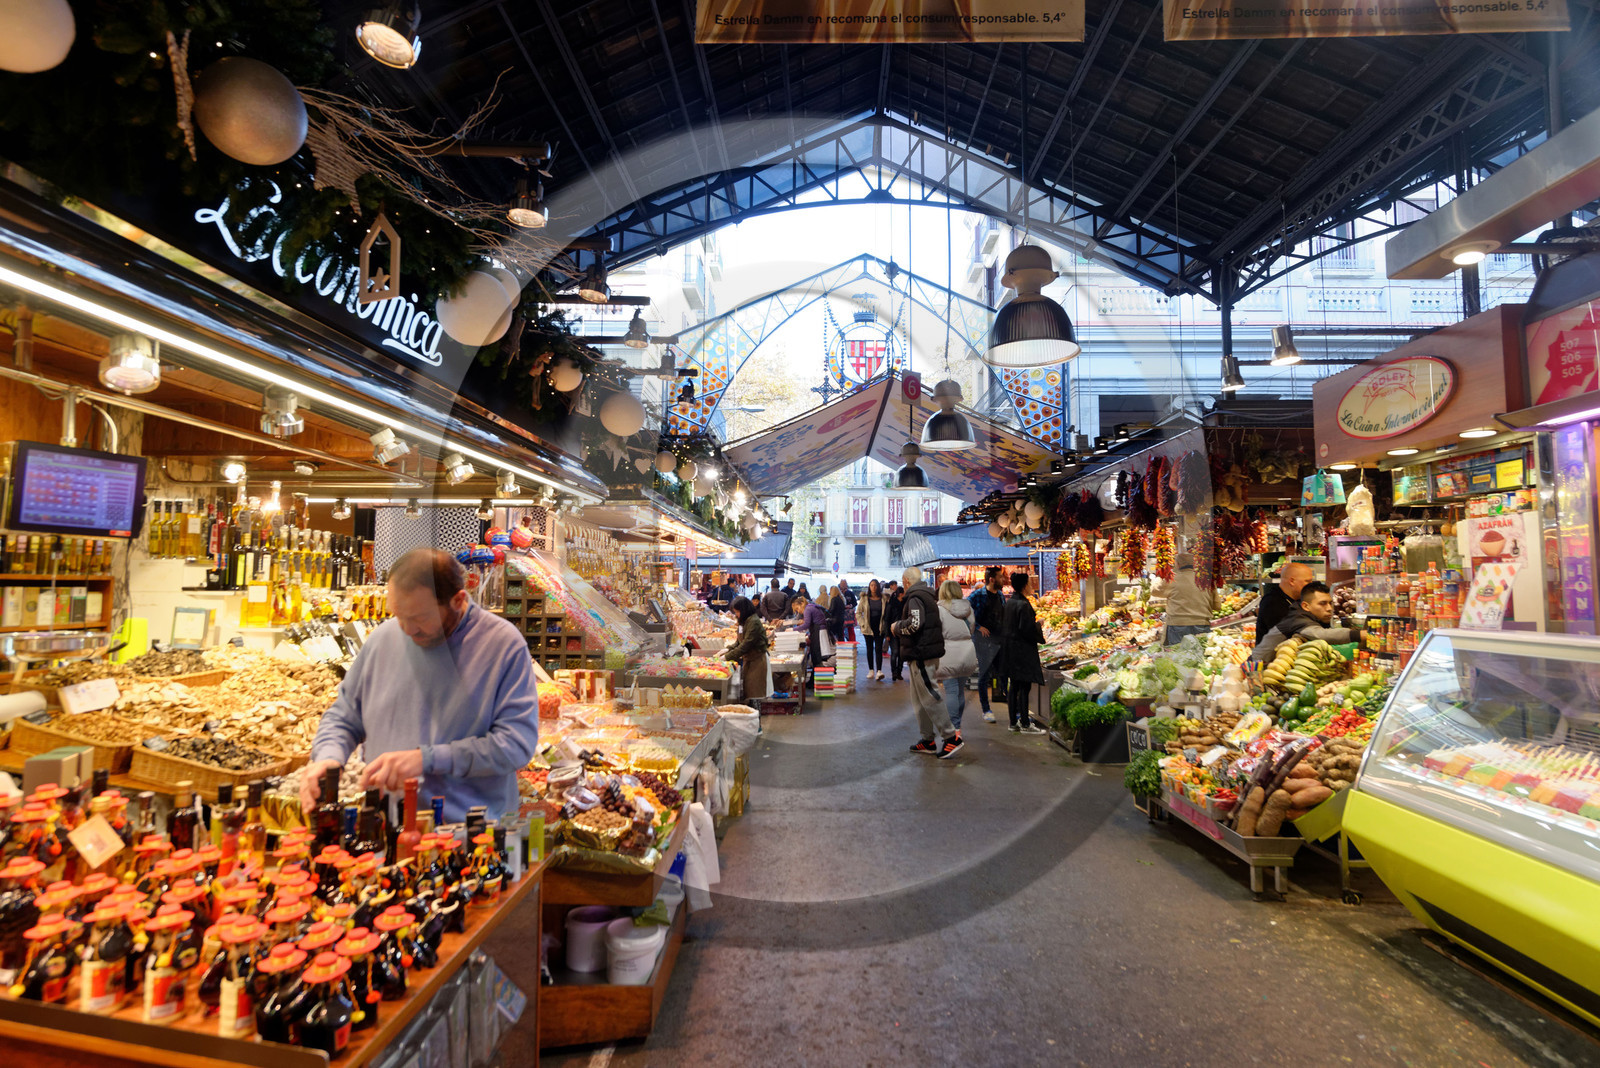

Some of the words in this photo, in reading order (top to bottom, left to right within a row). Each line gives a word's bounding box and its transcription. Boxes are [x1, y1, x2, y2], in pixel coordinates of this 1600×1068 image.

[1182, 7, 1230, 19] Estrella
[1234, 7, 1276, 18] Damm
[1279, 8, 1296, 17] en
[1300, 7, 1362, 17] recomana
[1366, 5, 1378, 16] el
[1382, 6, 1435, 16] consum
[1437, 2, 1523, 15] responsable.
[715, 14, 760, 26] Estrella
[764, 14, 804, 25] Damm
[807, 15, 823, 24] en
[826, 13, 887, 24] recomana
[891, 13, 902, 23] el
[905, 13, 955, 23] consum
[959, 12, 1039, 25] responsable.
[1042, 12, 1066, 24] 5,4°
[1560, 337, 1580, 351] 507
[1560, 351, 1582, 365] 506
[1561, 364, 1583, 378] 505
[907, 379, 917, 395] 6
[1340, 409, 1353, 427] La
[1353, 415, 1380, 432] Cuina
[1381, 372, 1448, 432] Internacional
